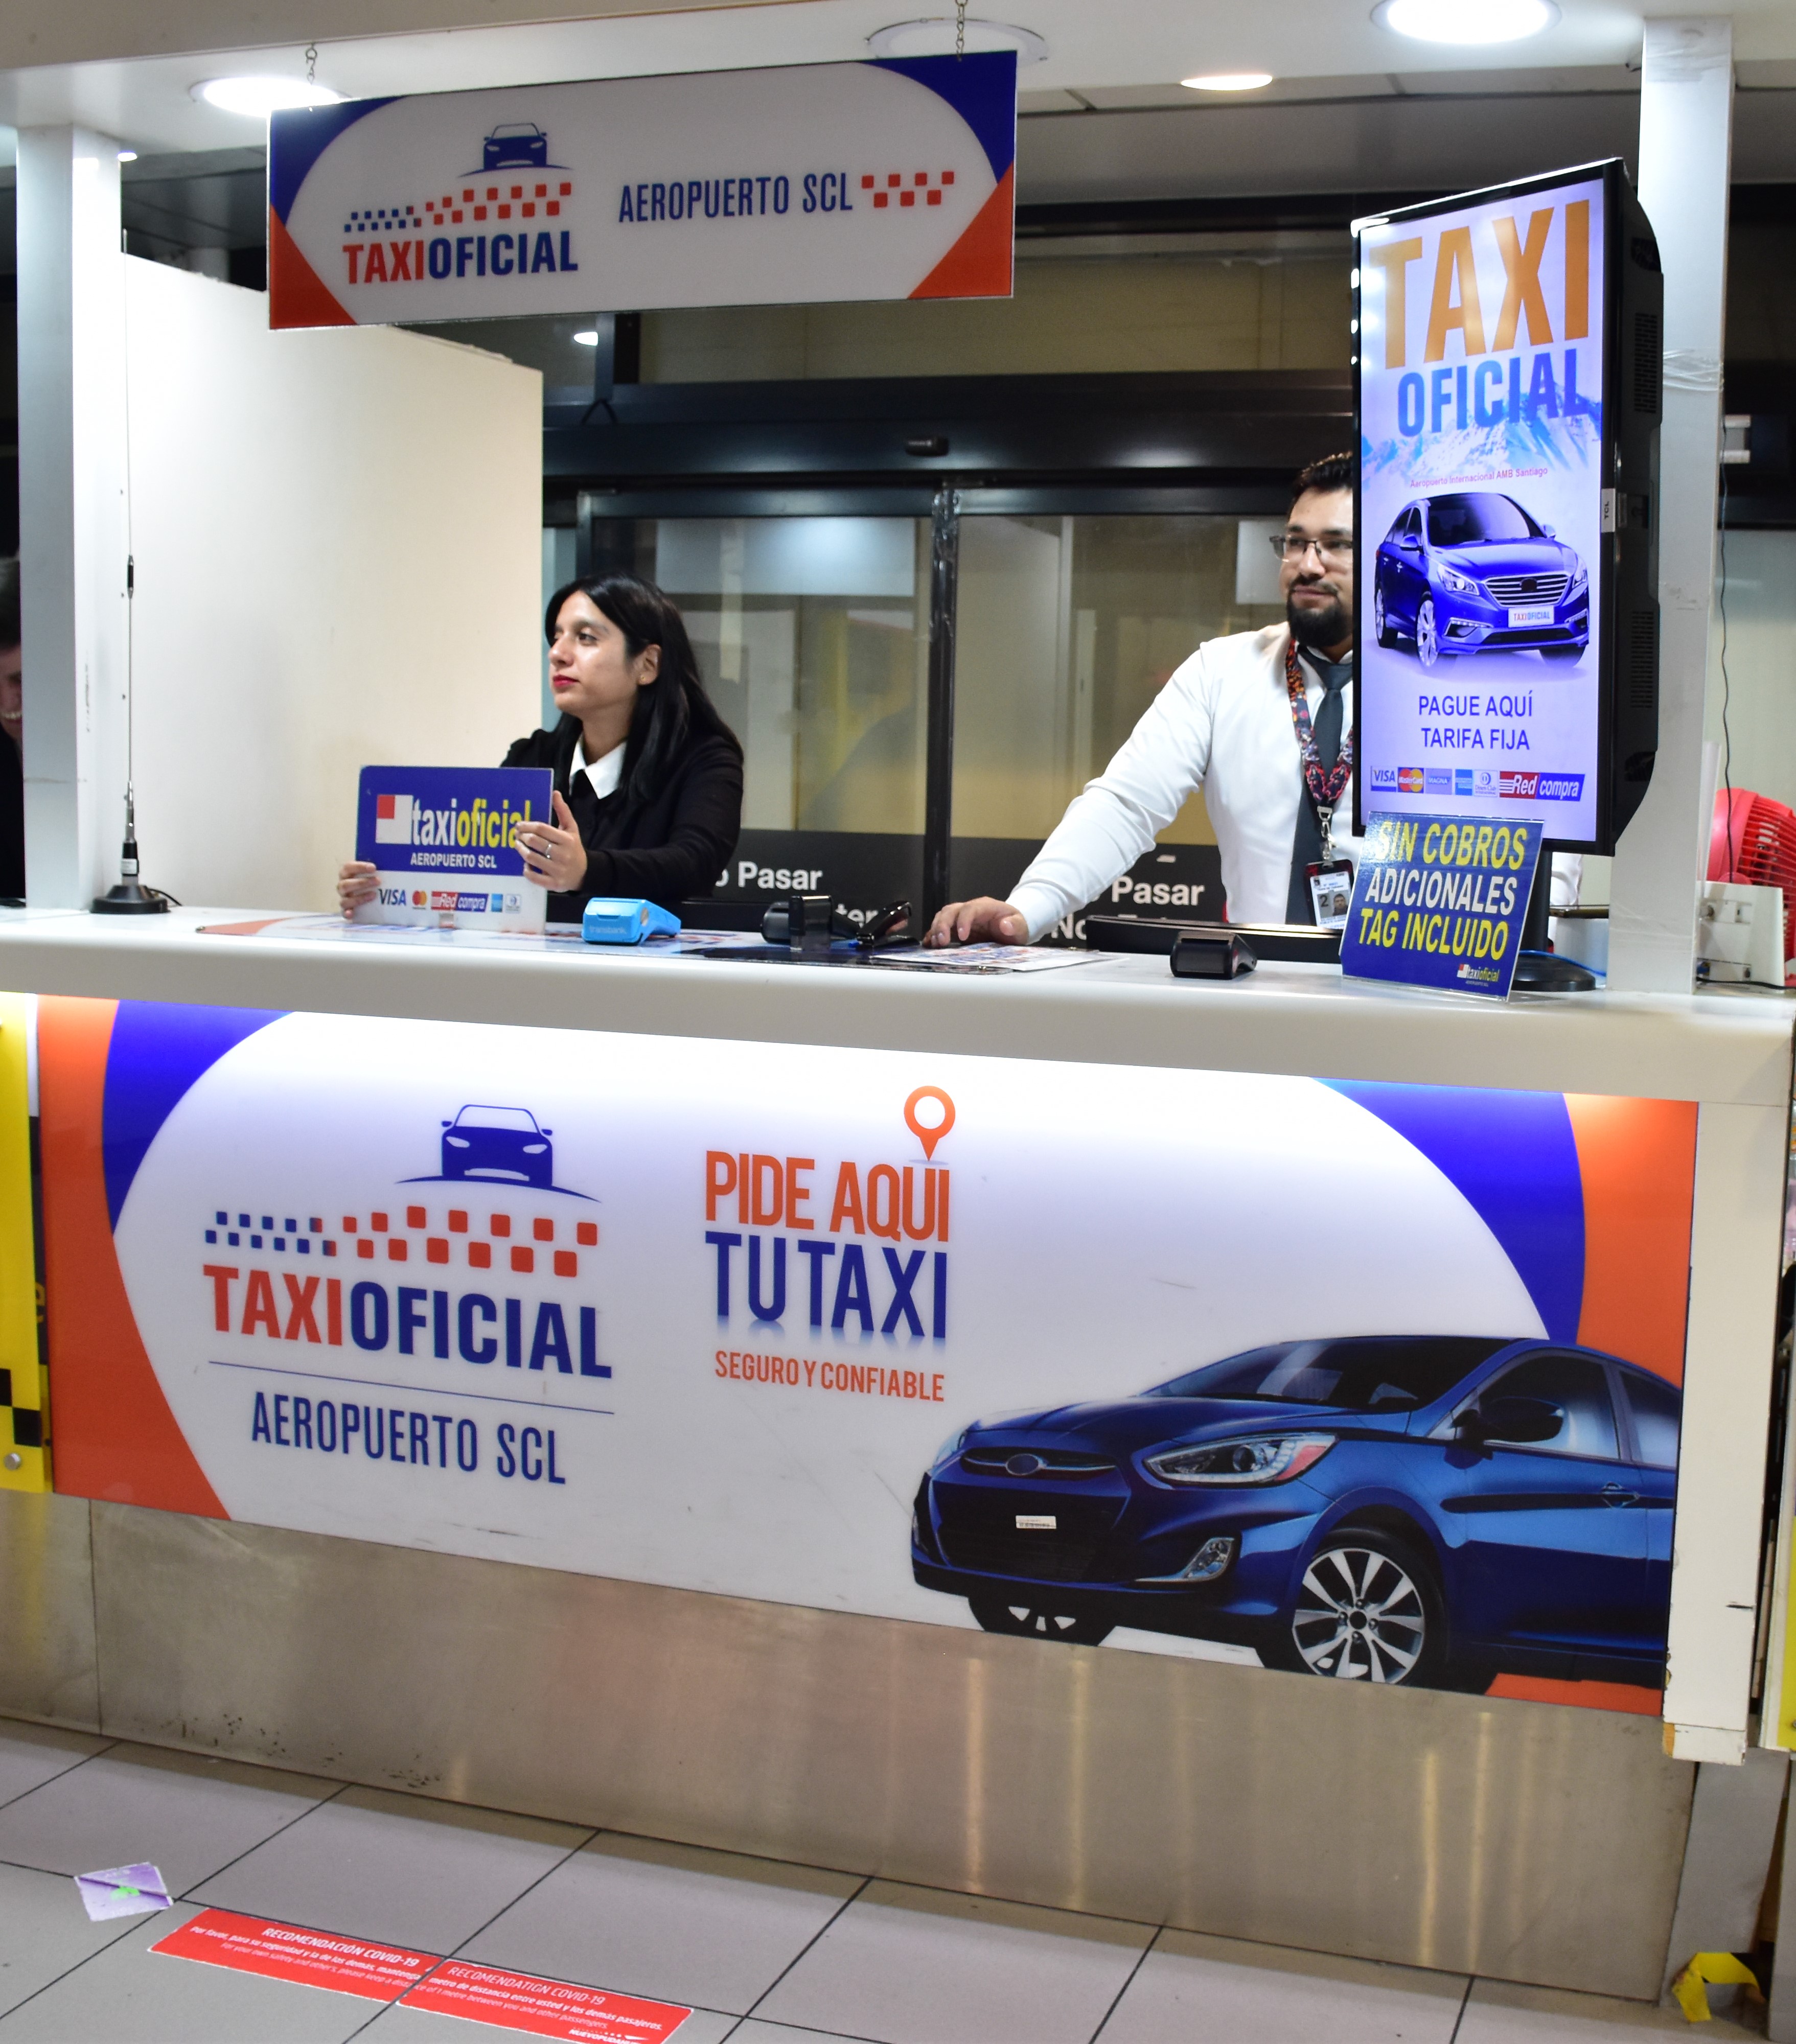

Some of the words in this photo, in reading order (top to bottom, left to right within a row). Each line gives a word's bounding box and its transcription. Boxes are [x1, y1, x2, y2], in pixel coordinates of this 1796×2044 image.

[618, 176, 790, 223] AEROPUERTO
[802, 172, 853, 214] SCL
[1368, 199, 1590, 369] TAXI
[1397, 348, 1590, 437] OFICIAL
[1410, 478, 1447, 489] Aeropuerto
[1449, 471, 1494, 484] Internacional
[1496, 469, 1513, 479] AMB
[1515, 467, 1548, 478] Santiago
[1419, 695, 1480, 715] PAGUE
[1486, 690, 1533, 717] AQUÍ
[1421, 728, 1484, 749] TARIFA
[1490, 729, 1530, 750] FIJA
[1374, 770, 1396, 782] VISA
[1512, 774, 1538, 795] Red
[1539, 780, 1579, 800] compra
[410, 852, 475, 868] AEROPUERTO
[478, 854, 497, 868] SCL
[1375, 821, 1418, 862] SIN
[1422, 823, 1528, 870] COBROS
[738, 861, 823, 891] Pasar
[1111, 875, 1205, 906] Pasar
[1365, 868, 1517, 915] ADICIONALES
[378, 888, 406, 905] VISA
[440, 893, 457, 908] Red
[457, 896, 485, 911] compra
[1359, 908, 1399, 947] TAG
[1402, 913, 1508, 960] INCLUIDO
[706, 1150, 815, 1230] PIDE
[705, 1230, 786, 1321] TU
[798, 1239, 947, 1338] TAXI
[715, 1351, 799, 1385] SEGURO
[803, 1360, 817, 1387] Y
[821, 1362, 944, 1402] CONFIABLE
[251, 1391, 478, 1473] AEROPUERTO
[497, 1423, 566, 1484] SCL
[261, 1927, 365, 1956] RECOMENDACIÓN
[363, 1949, 420, 1967] COVID-19
[428, 1978, 456, 1988] metro
[469, 1985, 511, 1999] distancia
[510, 1994, 536, 2004] entre
[535, 1999, 564, 2009] usted
[569, 2006, 585, 2014] los
[550, 1987, 606, 2005] COVID-19
